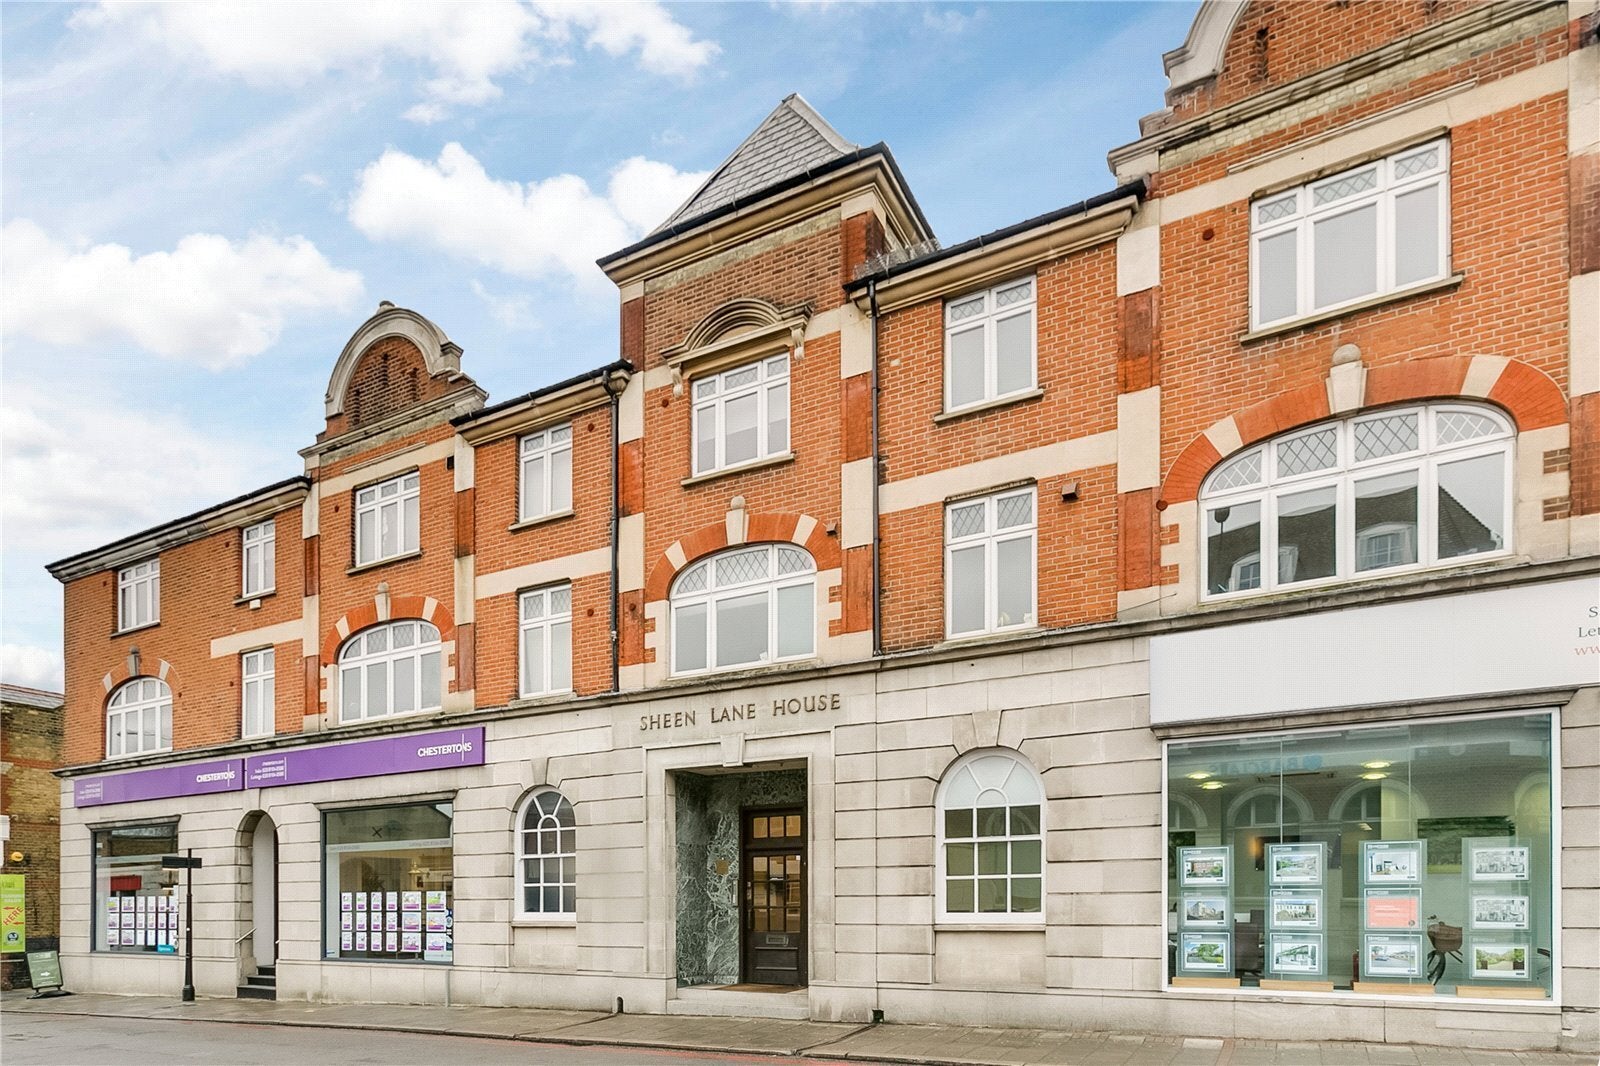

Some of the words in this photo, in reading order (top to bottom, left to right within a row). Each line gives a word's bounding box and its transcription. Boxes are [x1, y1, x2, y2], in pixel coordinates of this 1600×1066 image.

[639, 711, 697, 731] SHEEN
[710, 703, 756, 724] LANE
[772, 693, 841, 717] HOUSE
[417, 741, 473, 758] CHESTERTONS
[3, 906, 24, 926] HERE
